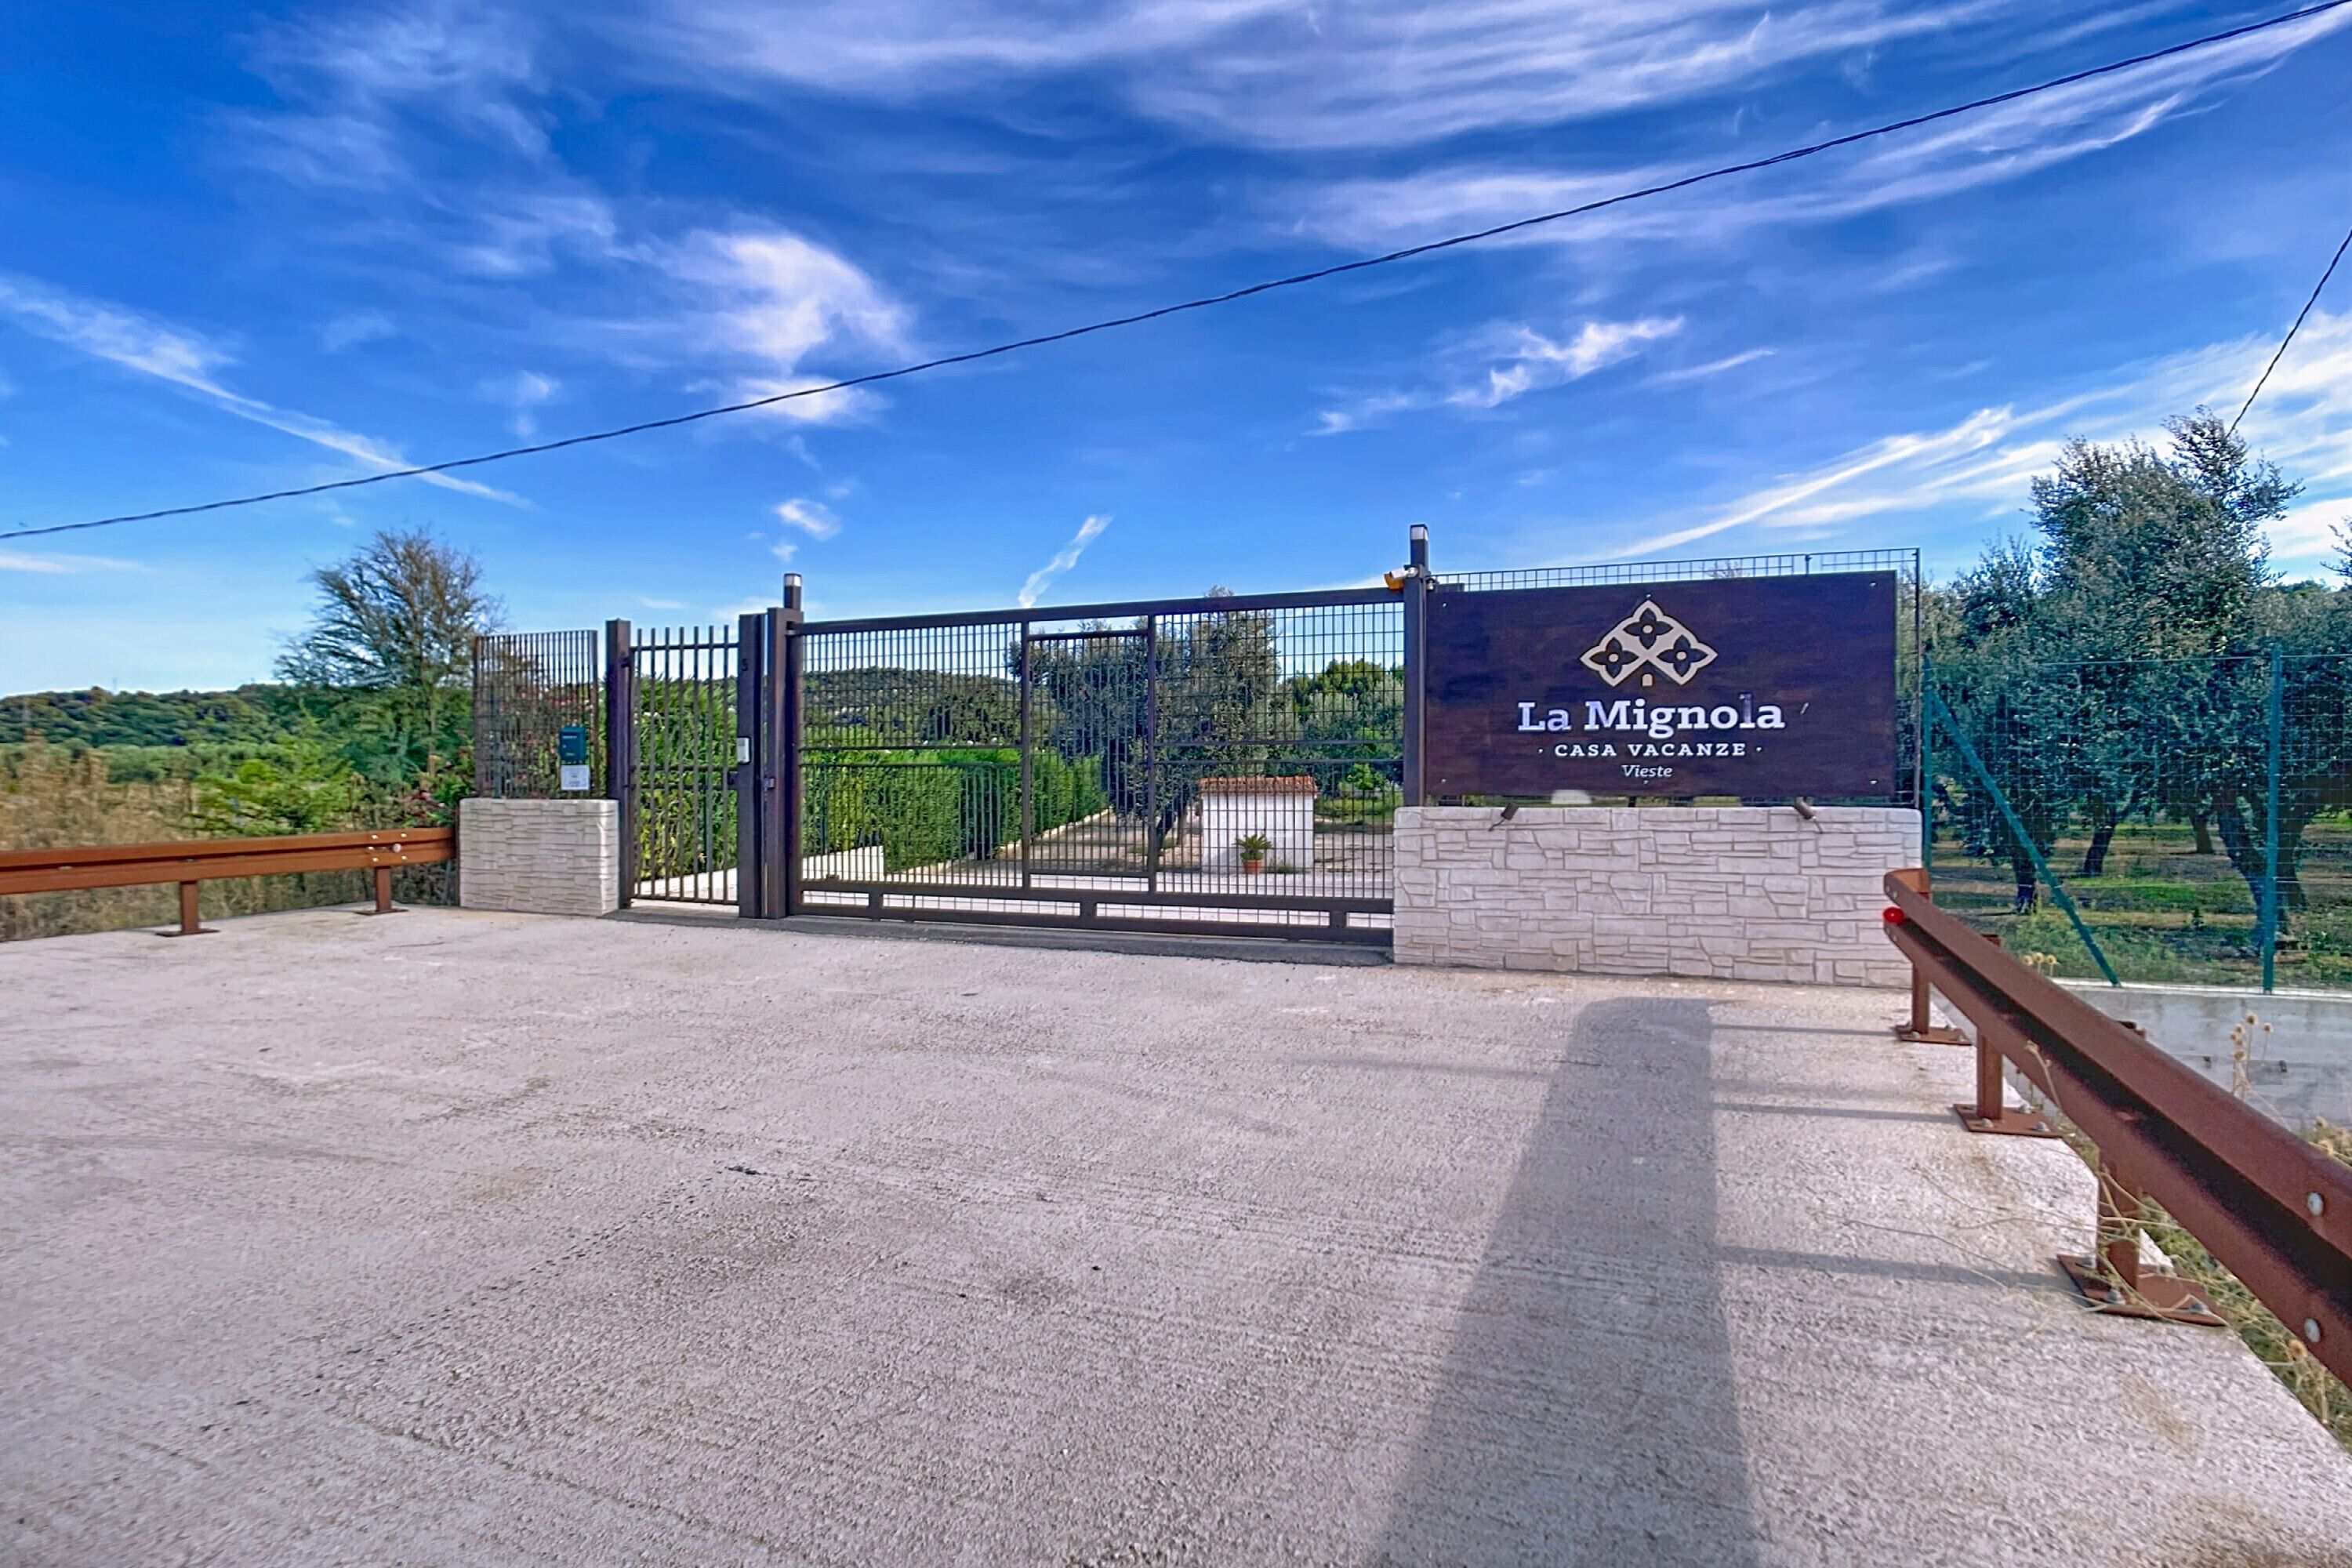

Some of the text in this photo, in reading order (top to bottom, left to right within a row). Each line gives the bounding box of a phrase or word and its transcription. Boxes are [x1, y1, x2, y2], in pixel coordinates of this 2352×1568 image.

[1517, 693, 1785, 739] La Mignola
[1554, 743, 1747, 757] CASA VACANZE
[1621, 764, 1673, 778] Vieste
